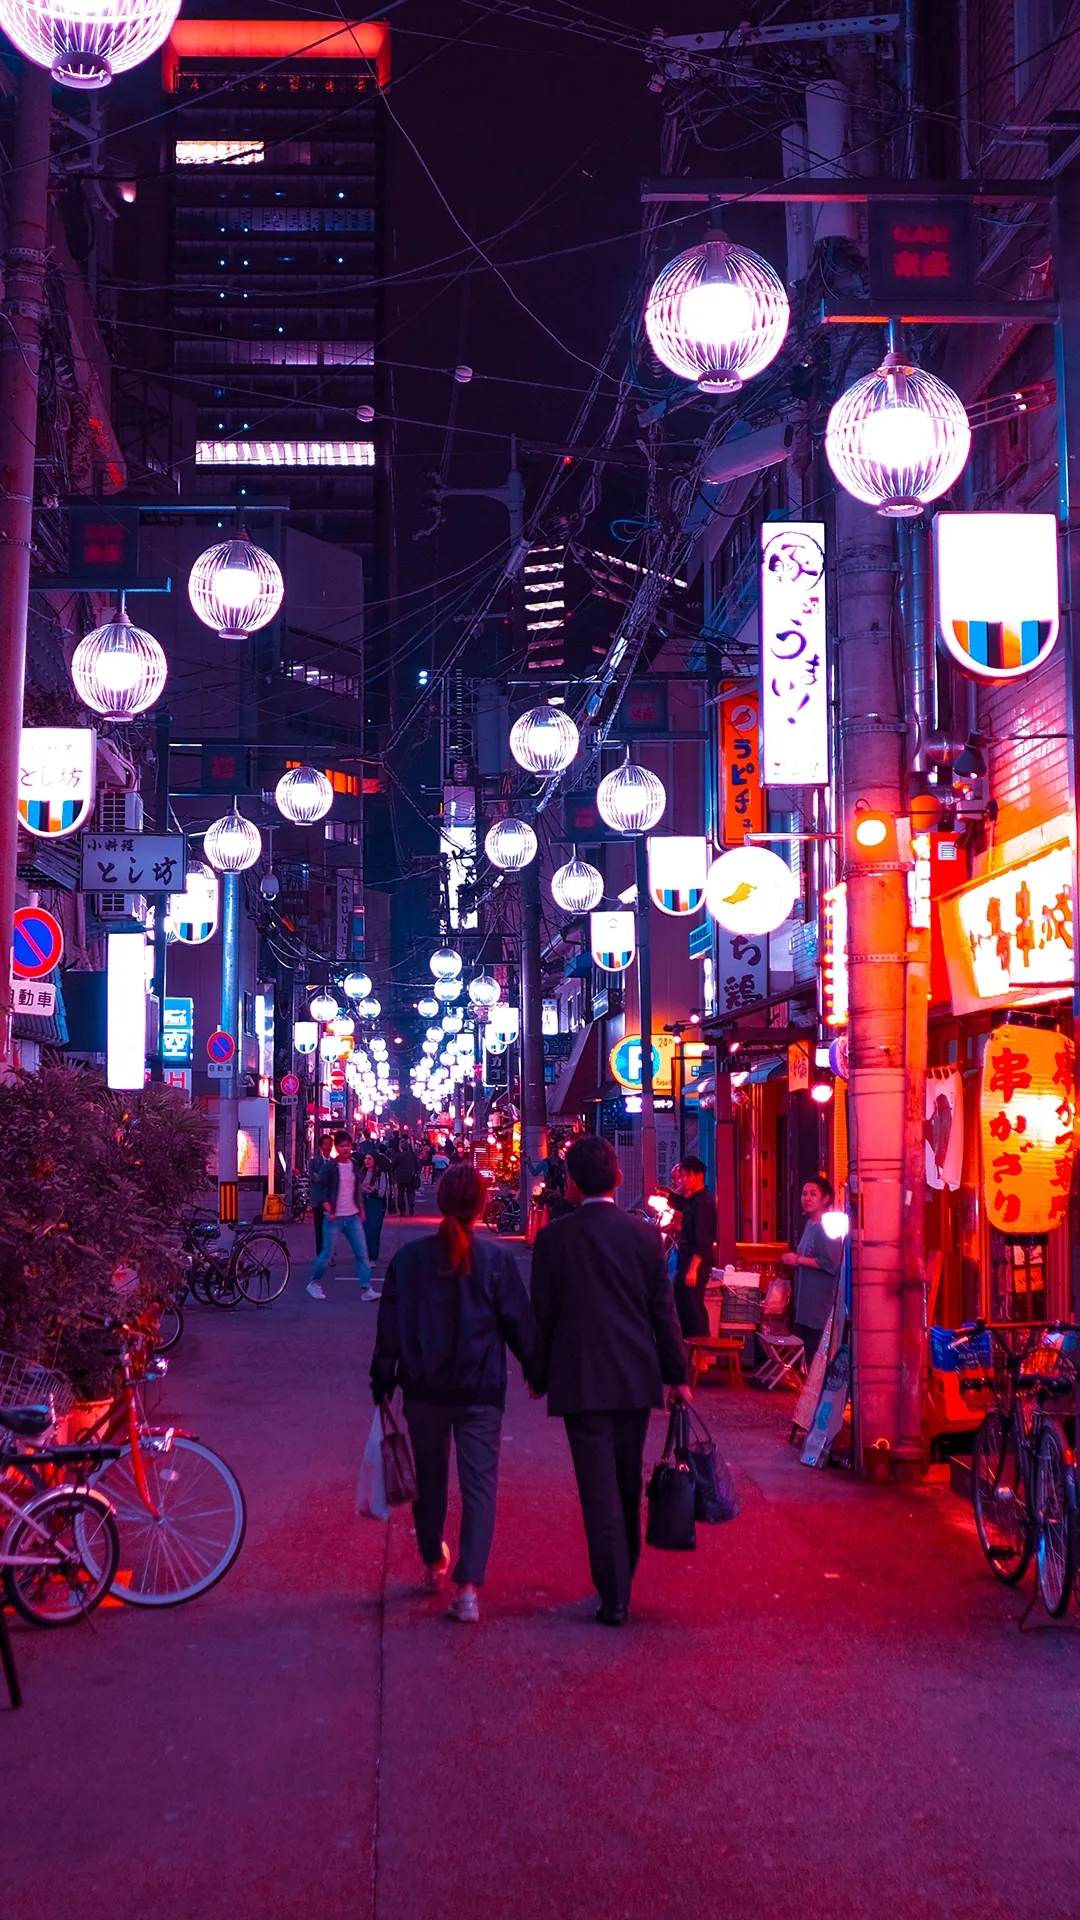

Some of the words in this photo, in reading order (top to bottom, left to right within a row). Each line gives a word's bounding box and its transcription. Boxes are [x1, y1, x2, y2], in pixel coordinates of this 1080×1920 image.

[20, 766, 83, 788] とし坊
[87, 838, 134, 852] 小料理
[97, 856, 177, 886] とし坊
[990, 1047, 1036, 1223] 串かざり
